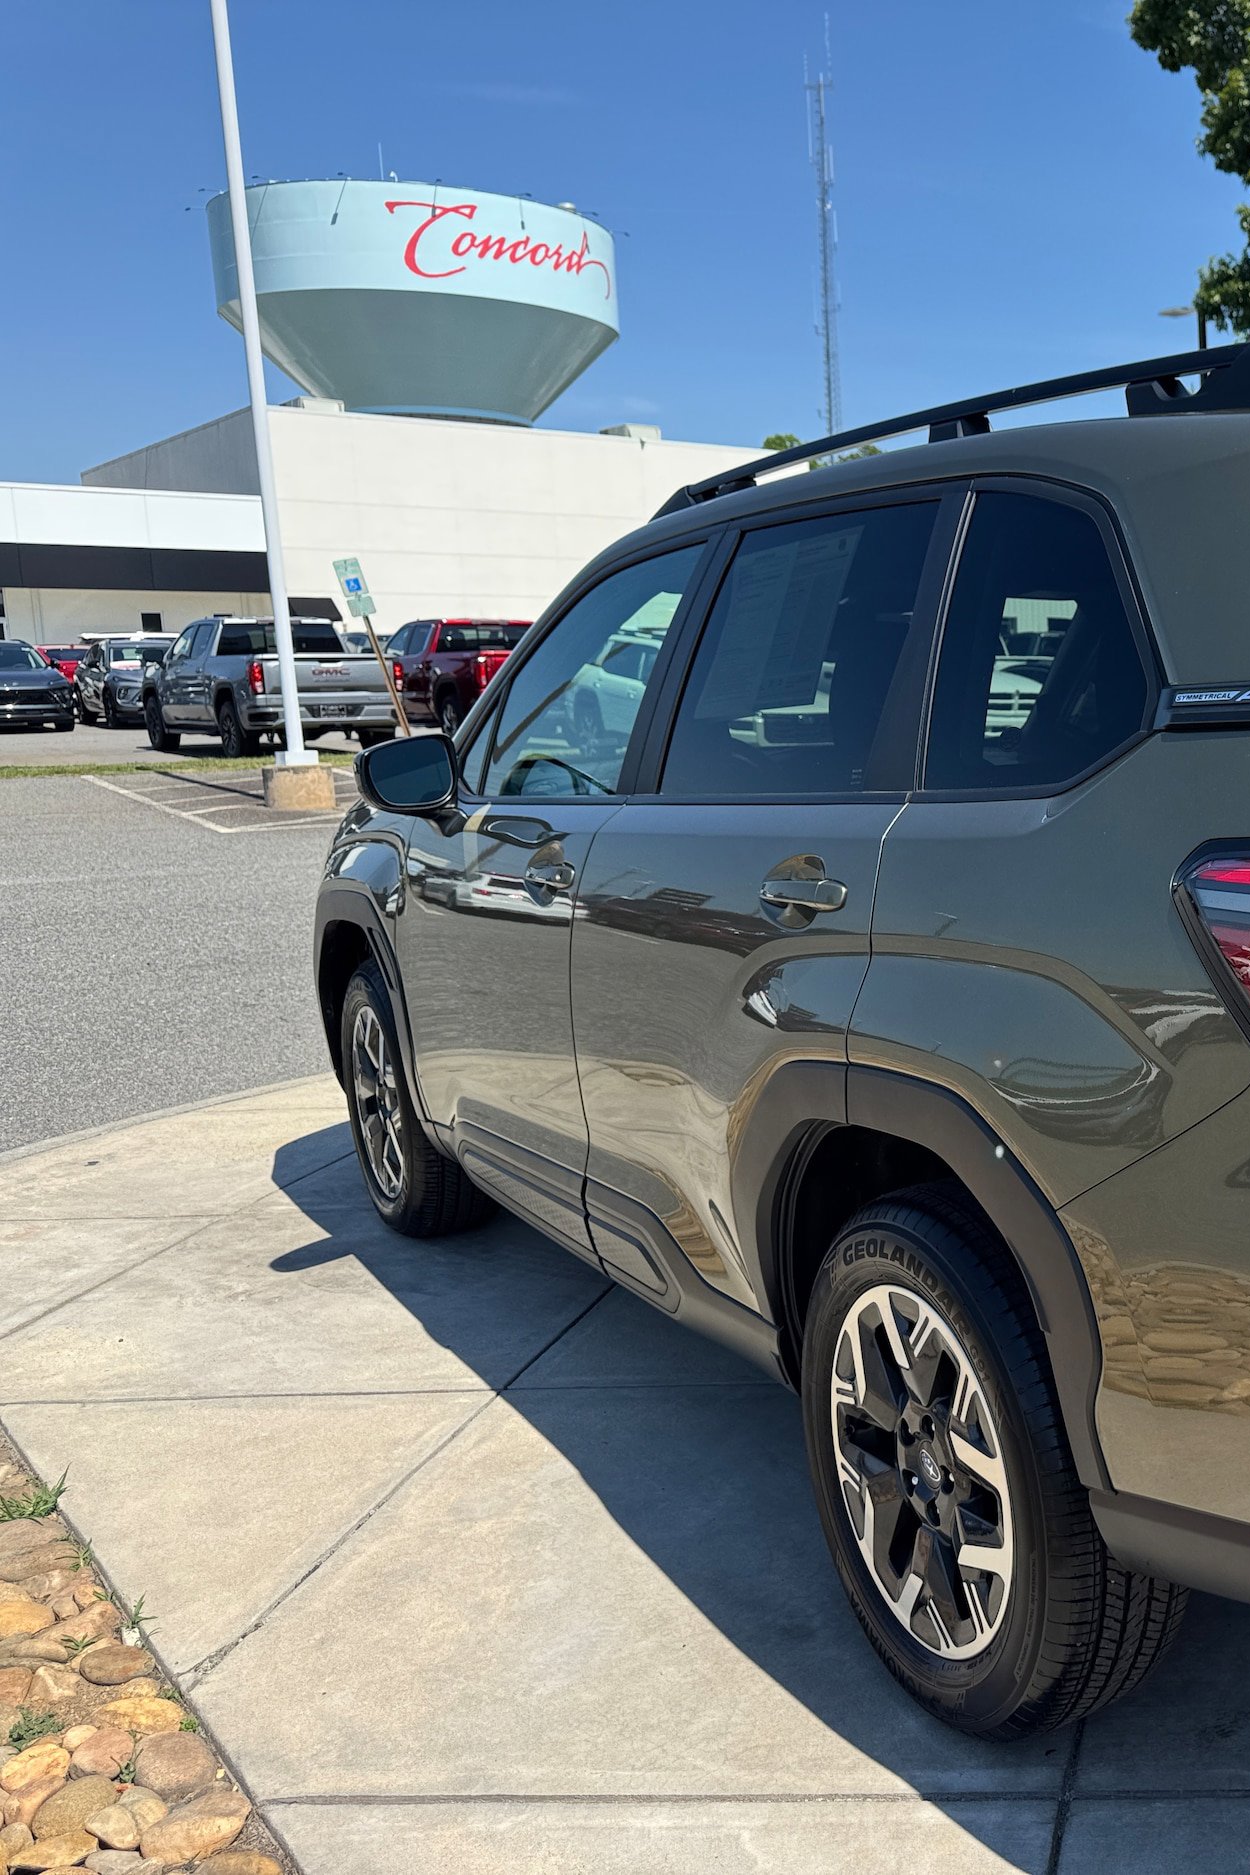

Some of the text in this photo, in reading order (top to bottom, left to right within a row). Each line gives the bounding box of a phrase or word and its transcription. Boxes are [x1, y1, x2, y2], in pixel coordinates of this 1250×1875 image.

[385, 201, 611, 300] Concord
[312, 668, 351, 677] GMC
[1176, 692, 1233, 702] SYMMETRICAL
[842, 1238, 973, 1344] GEOLANDAR
